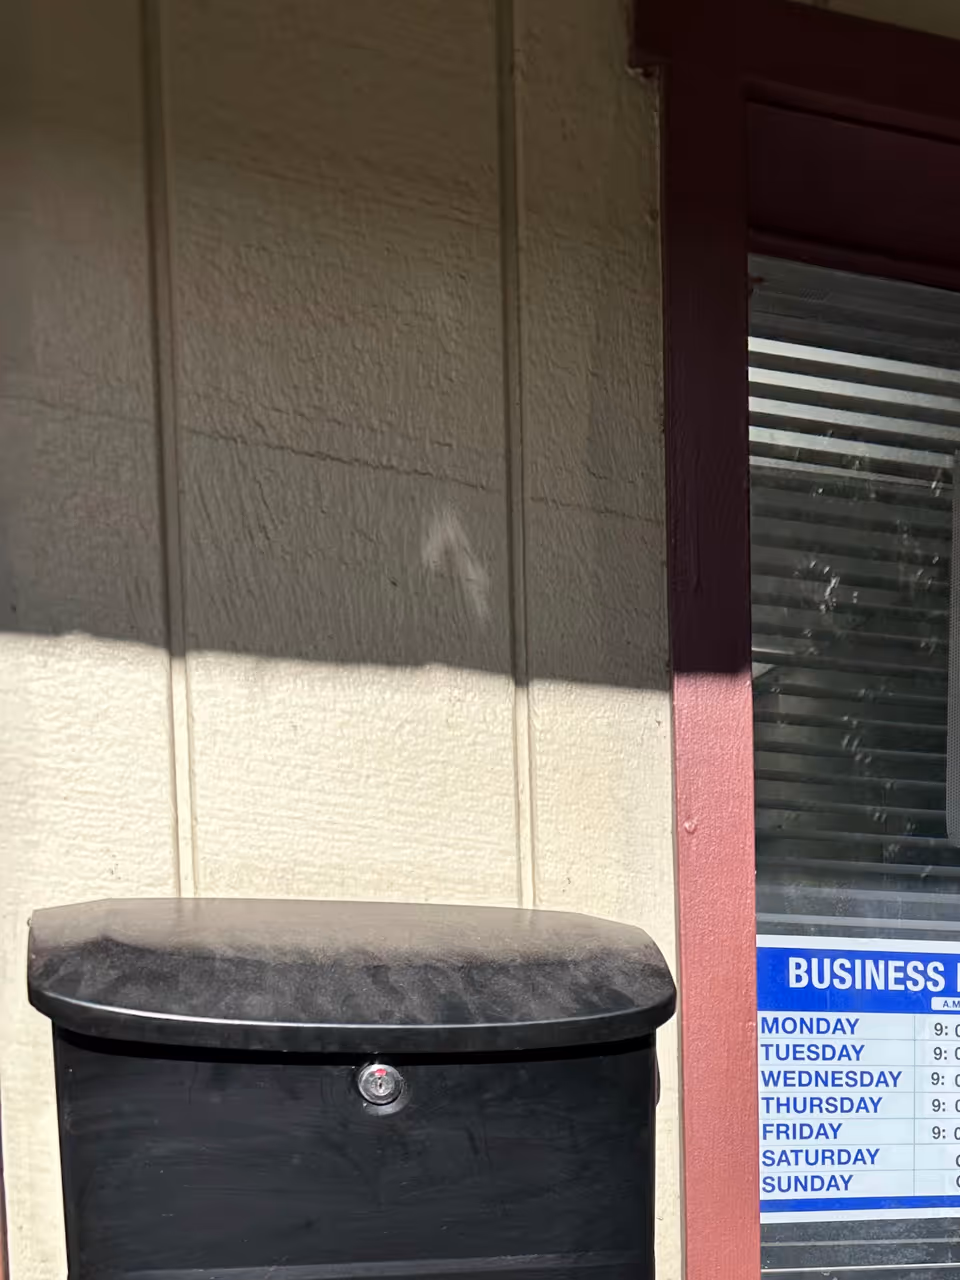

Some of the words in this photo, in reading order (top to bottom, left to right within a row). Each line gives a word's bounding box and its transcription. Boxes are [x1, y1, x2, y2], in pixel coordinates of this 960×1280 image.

[788, 957, 946, 993] BUSINESS
[760, 1017, 860, 1036] MONDAY
[760, 1044, 865, 1062] TUESDAY
[761, 1070, 903, 1089] WEDNESDAY
[761, 1096, 883, 1115] THURSDAY
[762, 1123, 843, 1141] FRIDAY
[761, 1148, 880, 1167] SATURDAY
[761, 1174, 854, 1193] SUNDAY
